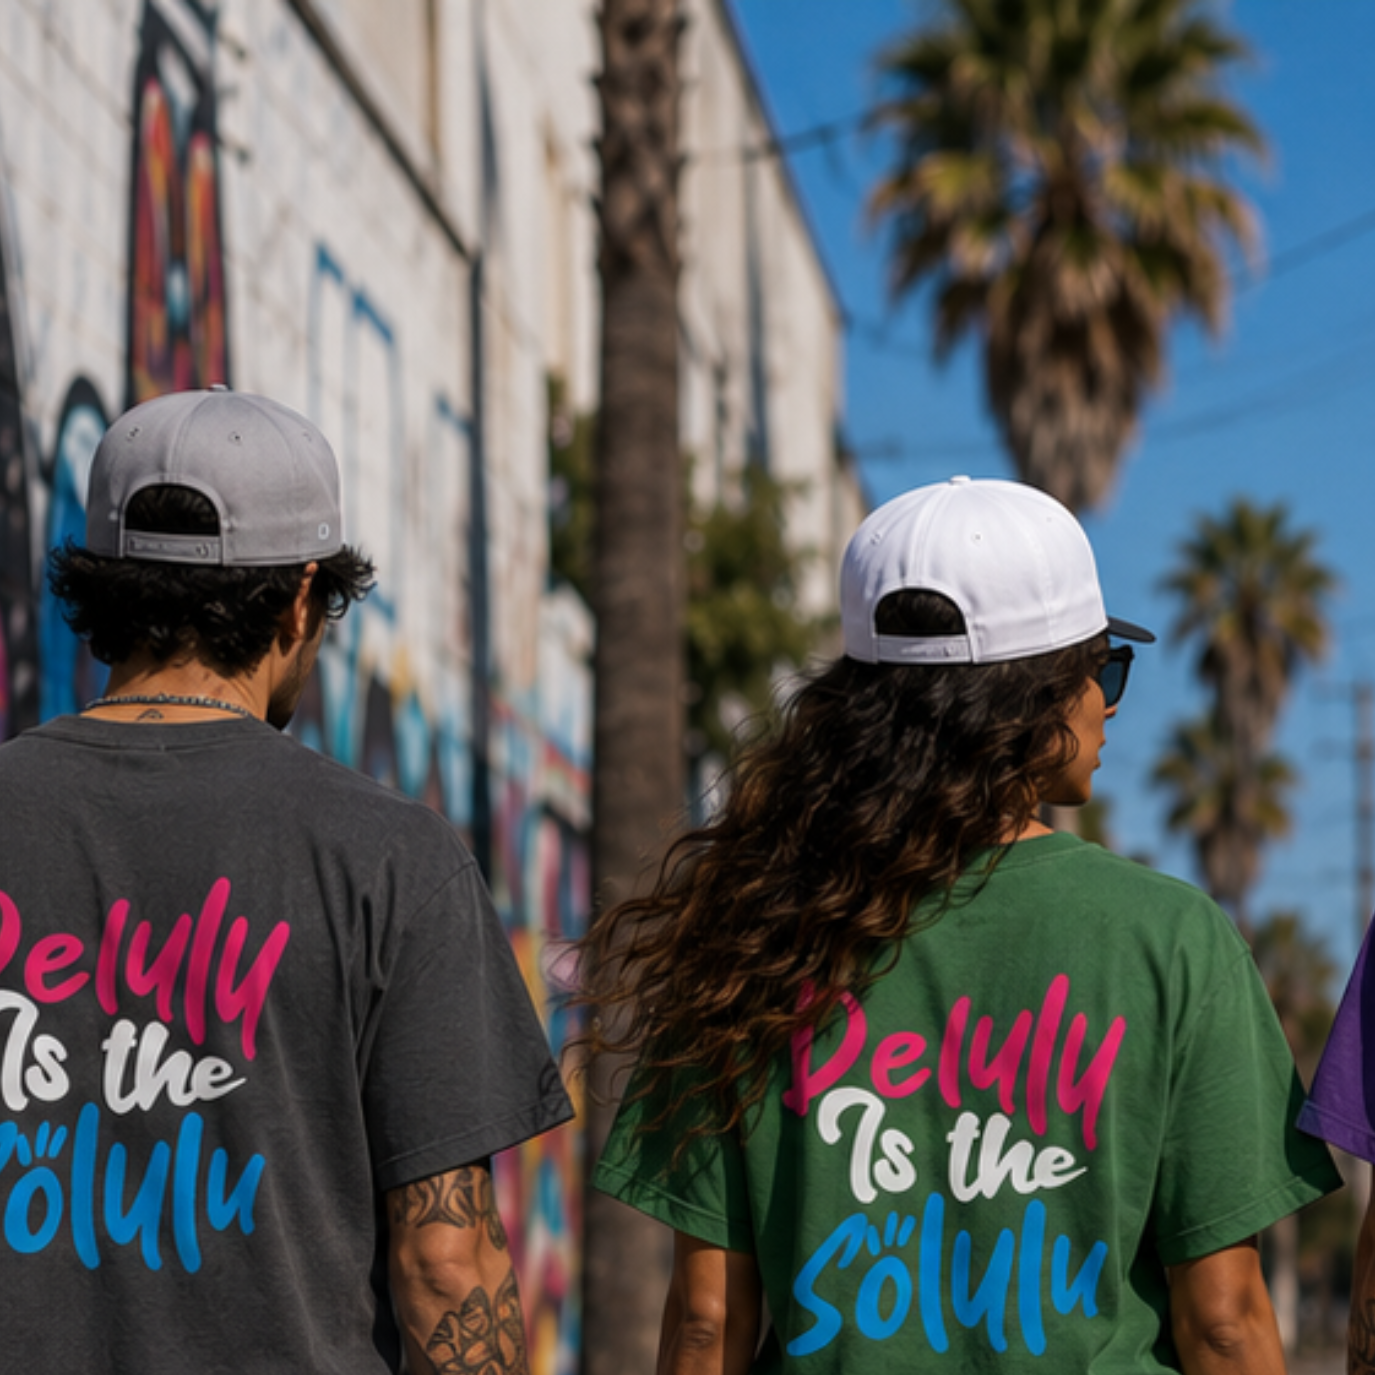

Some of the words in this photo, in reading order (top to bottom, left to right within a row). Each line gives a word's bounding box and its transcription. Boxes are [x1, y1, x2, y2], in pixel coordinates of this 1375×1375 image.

[101, 1019, 247, 1114] the
[816, 1085, 918, 1205] Is
[945, 1111, 1088, 1202] the
